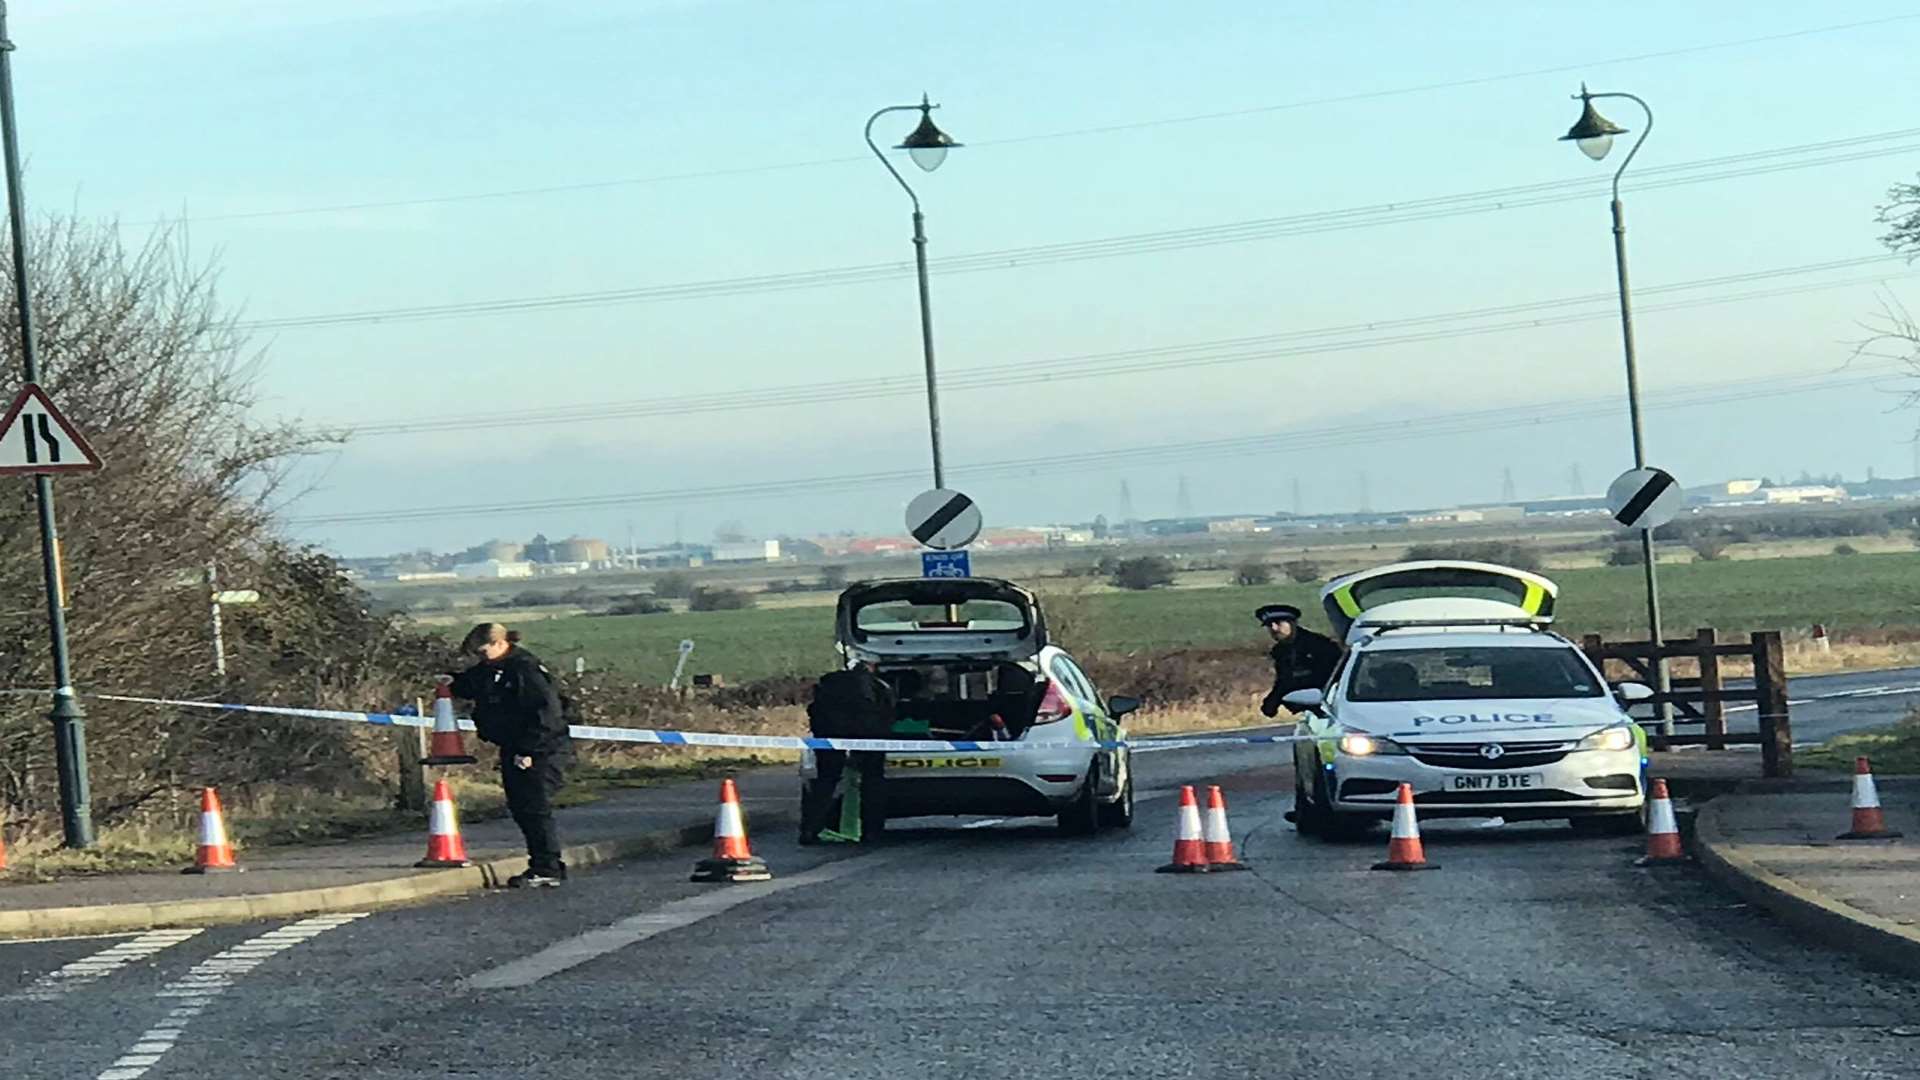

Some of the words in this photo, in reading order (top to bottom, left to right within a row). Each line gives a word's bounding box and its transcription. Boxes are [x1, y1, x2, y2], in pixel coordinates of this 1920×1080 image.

[1413, 713, 1556, 727] POLICE
[1454, 775, 1493, 790] GN17
[1498, 773, 1532, 789] BTE
